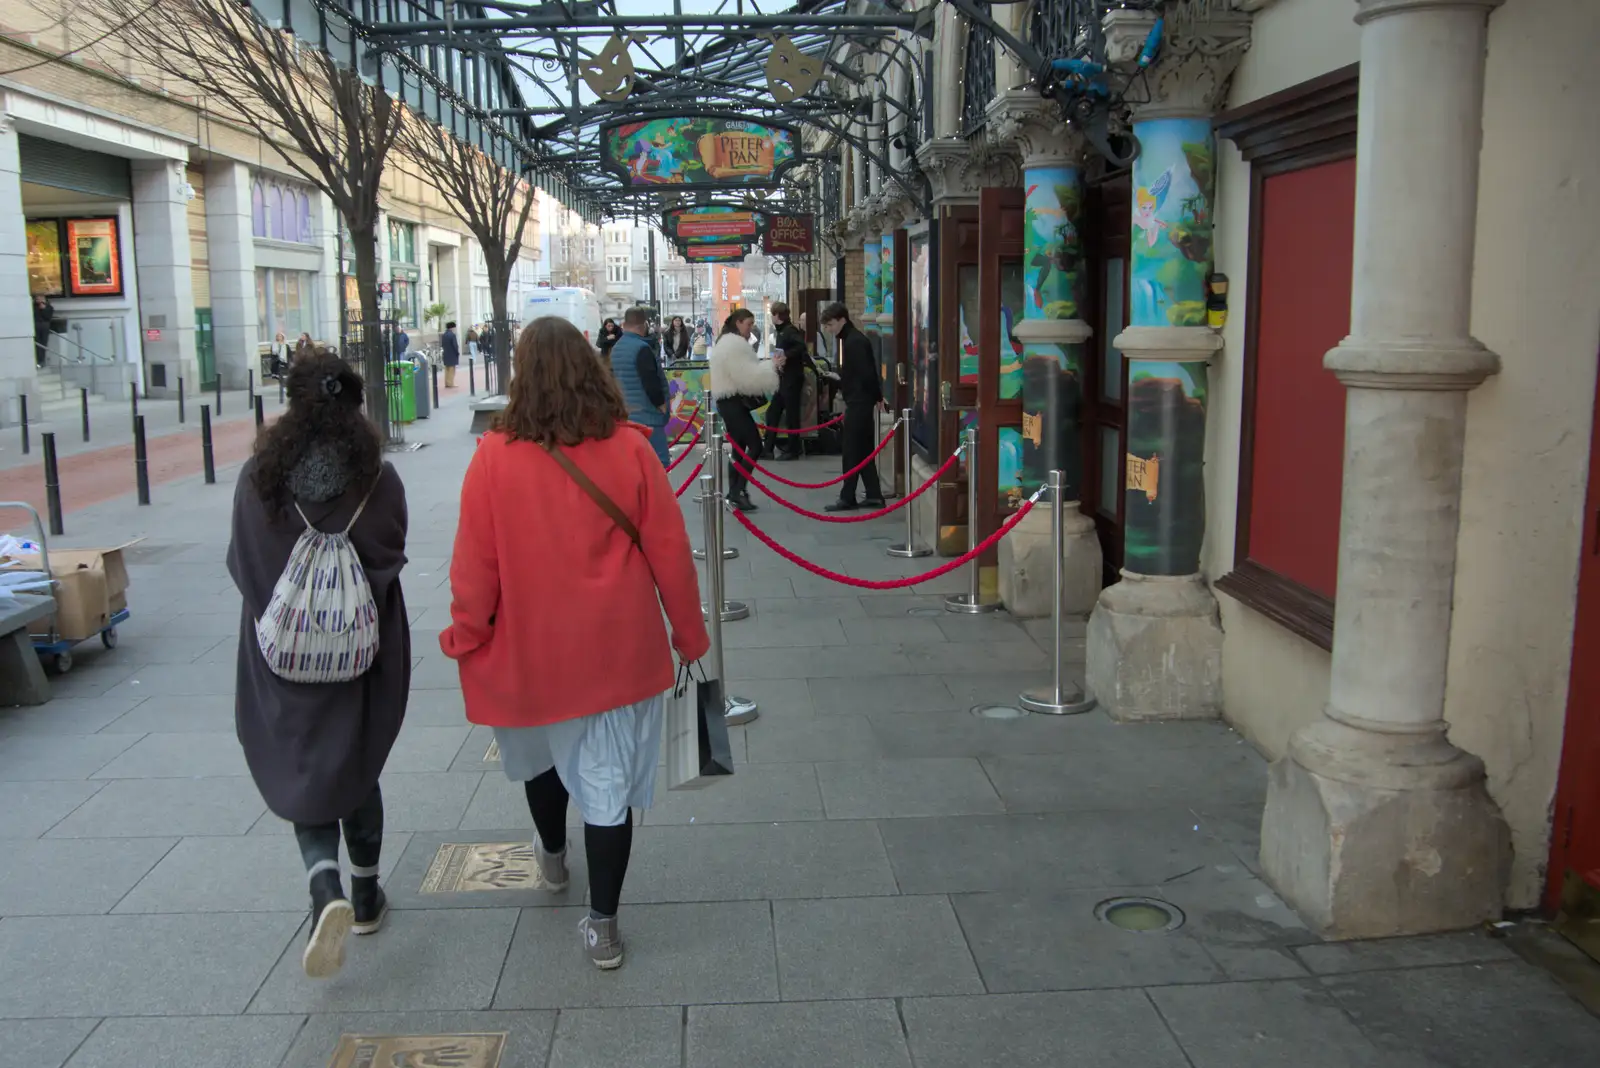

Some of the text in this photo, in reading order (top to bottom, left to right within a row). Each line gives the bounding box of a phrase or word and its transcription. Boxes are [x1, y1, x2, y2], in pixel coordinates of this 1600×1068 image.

[721, 136, 765, 153] PETER
[729, 150, 760, 169] PAN
[770, 228, 807, 240] OFFICE
